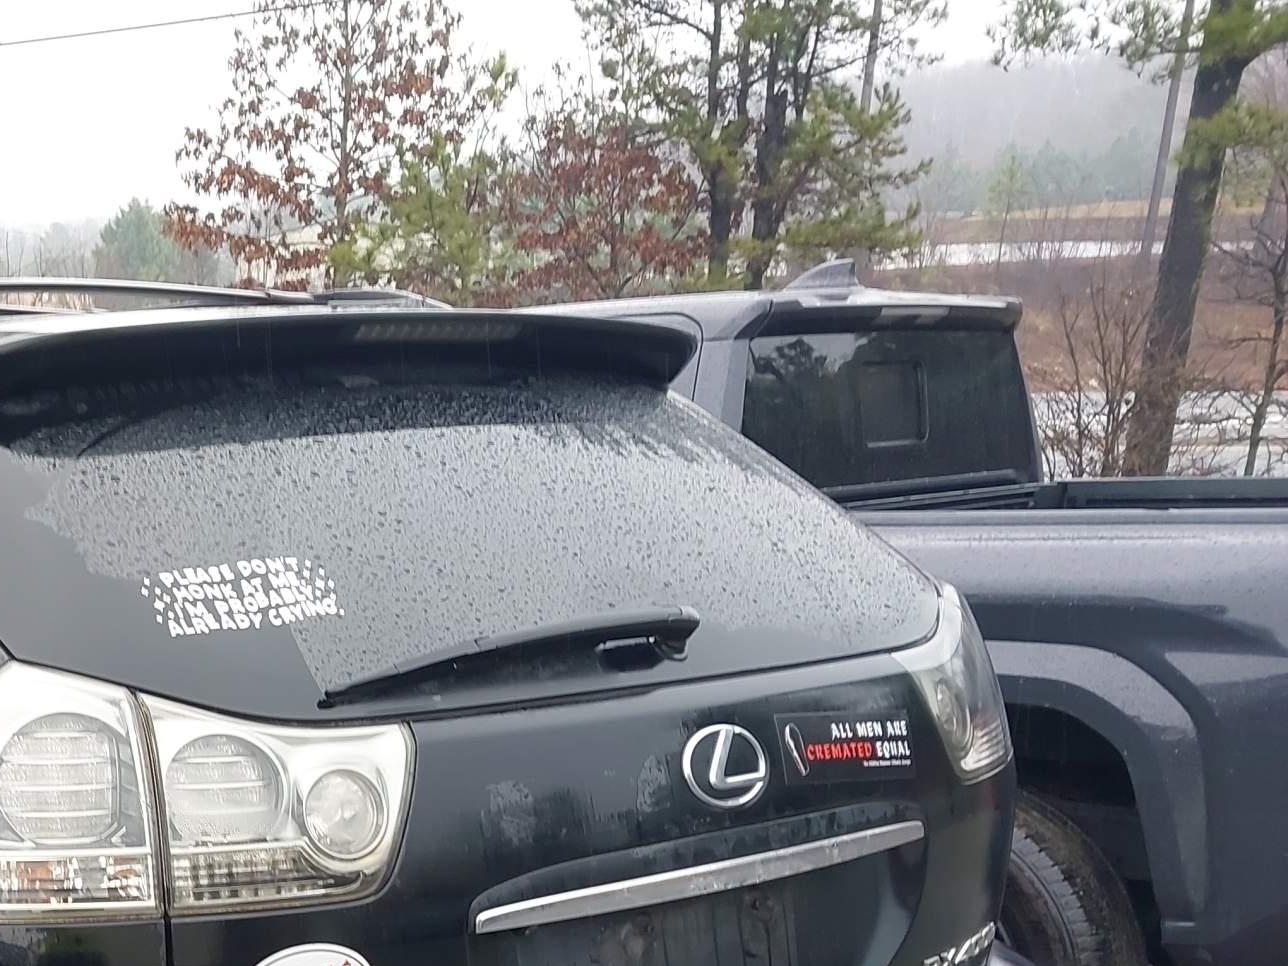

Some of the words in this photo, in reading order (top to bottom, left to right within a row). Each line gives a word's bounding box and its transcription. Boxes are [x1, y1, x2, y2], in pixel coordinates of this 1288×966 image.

[158, 563, 235, 588] PLEASE
[236, 556, 299, 578] DON'T
[240, 577, 263, 598] AT
[213, 585, 314, 615] PROBABLY
[167, 612, 263, 638] ALREADY
[830, 721, 853, 741] ALL
[855, 720, 883, 738] MEN
[886, 719, 908, 738] ARE
[806, 741, 873, 761] CREMATED
[875, 739, 912, 759] EQUAL
